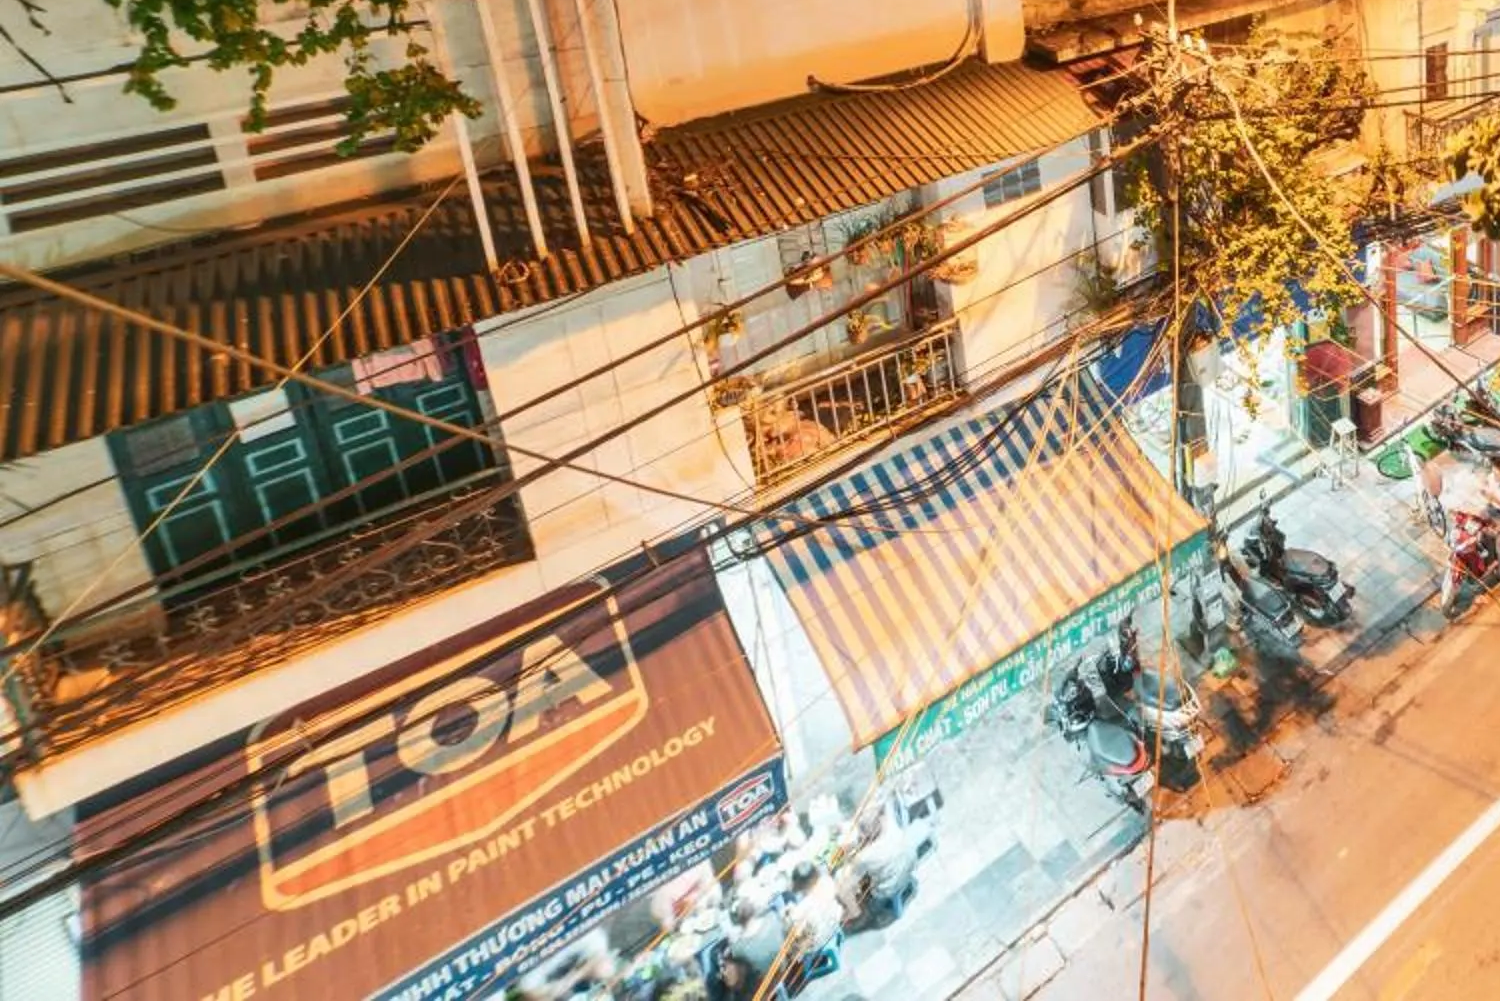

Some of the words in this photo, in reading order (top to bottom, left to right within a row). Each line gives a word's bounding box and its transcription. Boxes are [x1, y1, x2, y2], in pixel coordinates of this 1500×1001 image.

[287, 633, 612, 830] TOA
[679, 810, 708, 841] AN
[722, 783, 769, 818] TOA
[262, 894, 402, 987] LEADER
[405, 870, 443, 907] IN
[448, 817, 537, 885] PAINT
[540, 716, 716, 827] TECHNOLOGY
[580, 891, 612, 918] PU
[669, 833, 711, 863] KEO
